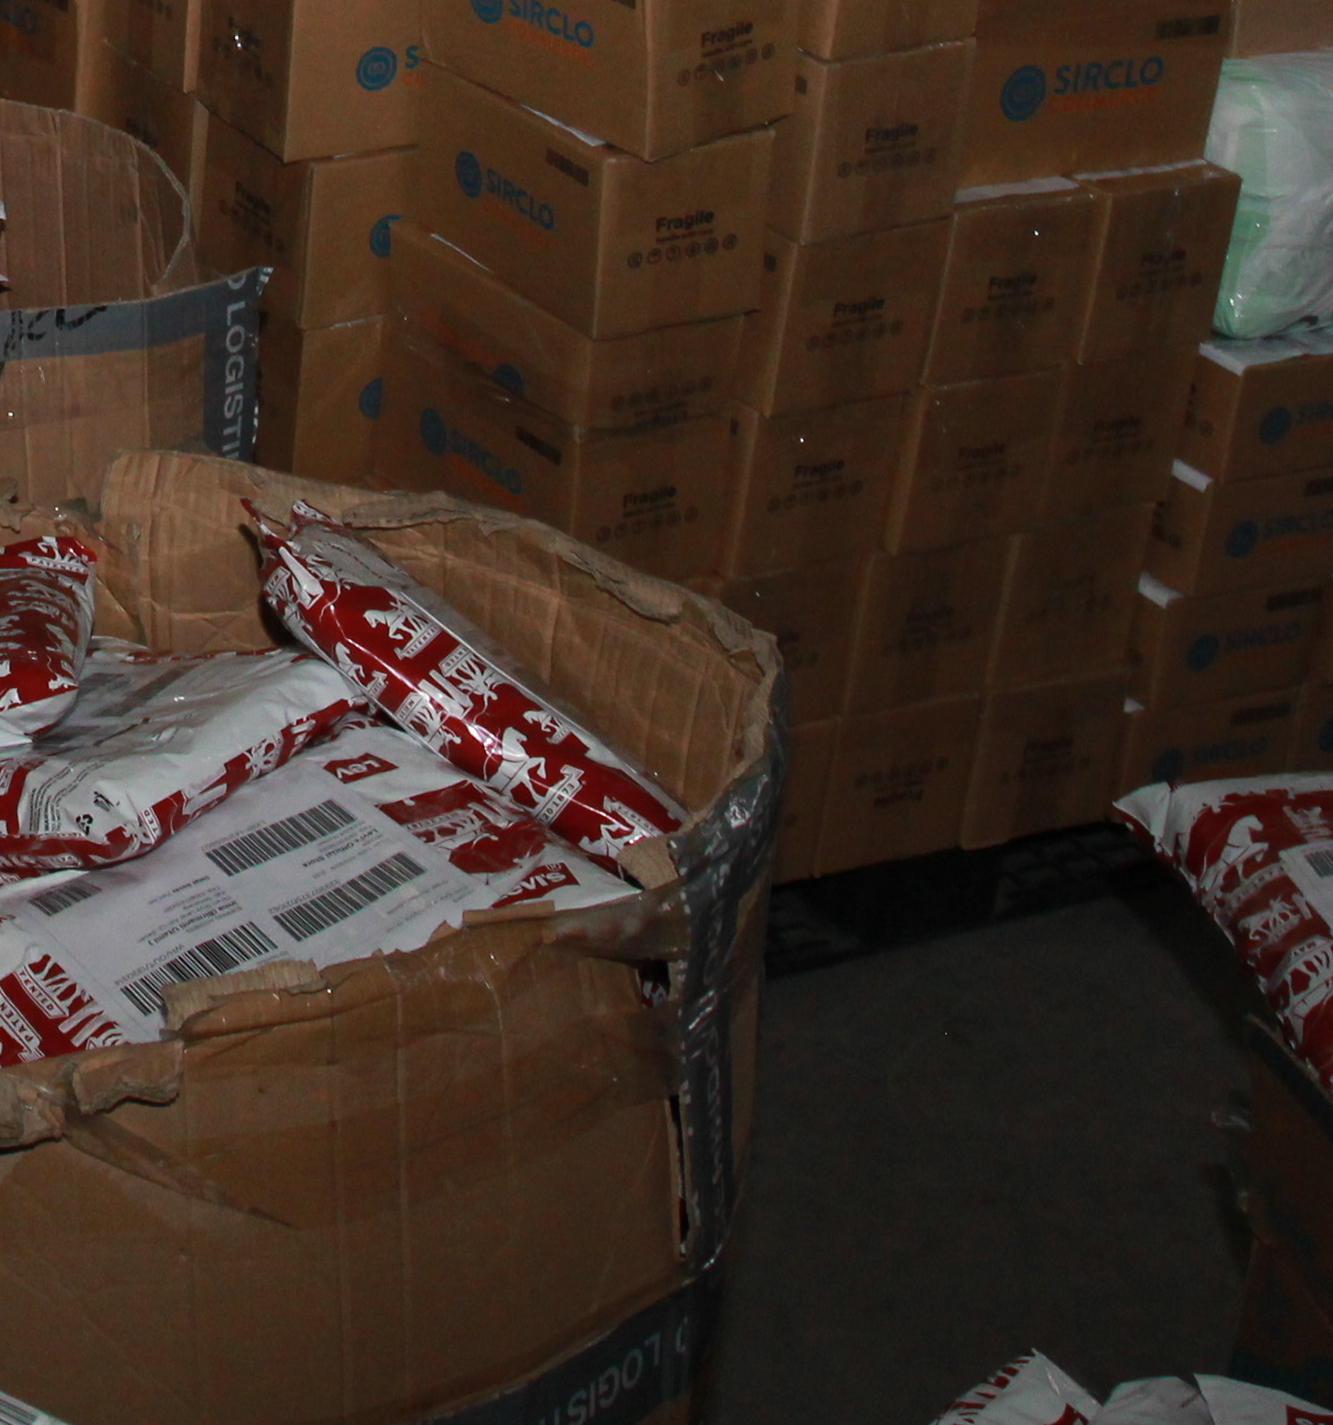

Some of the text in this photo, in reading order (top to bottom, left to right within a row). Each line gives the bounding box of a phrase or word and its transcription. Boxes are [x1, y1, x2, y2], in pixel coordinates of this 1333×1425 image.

[701, 21, 754, 50] Fragile
[1053, 56, 1164, 95] SIRCLO
[865, 121, 919, 147] Fragile
[480, 165, 556, 231] SIRCLO
[655, 209, 715, 234] Fragile
[987, 271, 1038, 296] Fragile
[833, 296, 885, 320] Fragile
[224, 300, 249, 464] LOGISTI
[794, 459, 845, 483] Fragile
[622, 485, 677, 511] Fragile
[302, 828, 379, 869] Levi's Official Store
